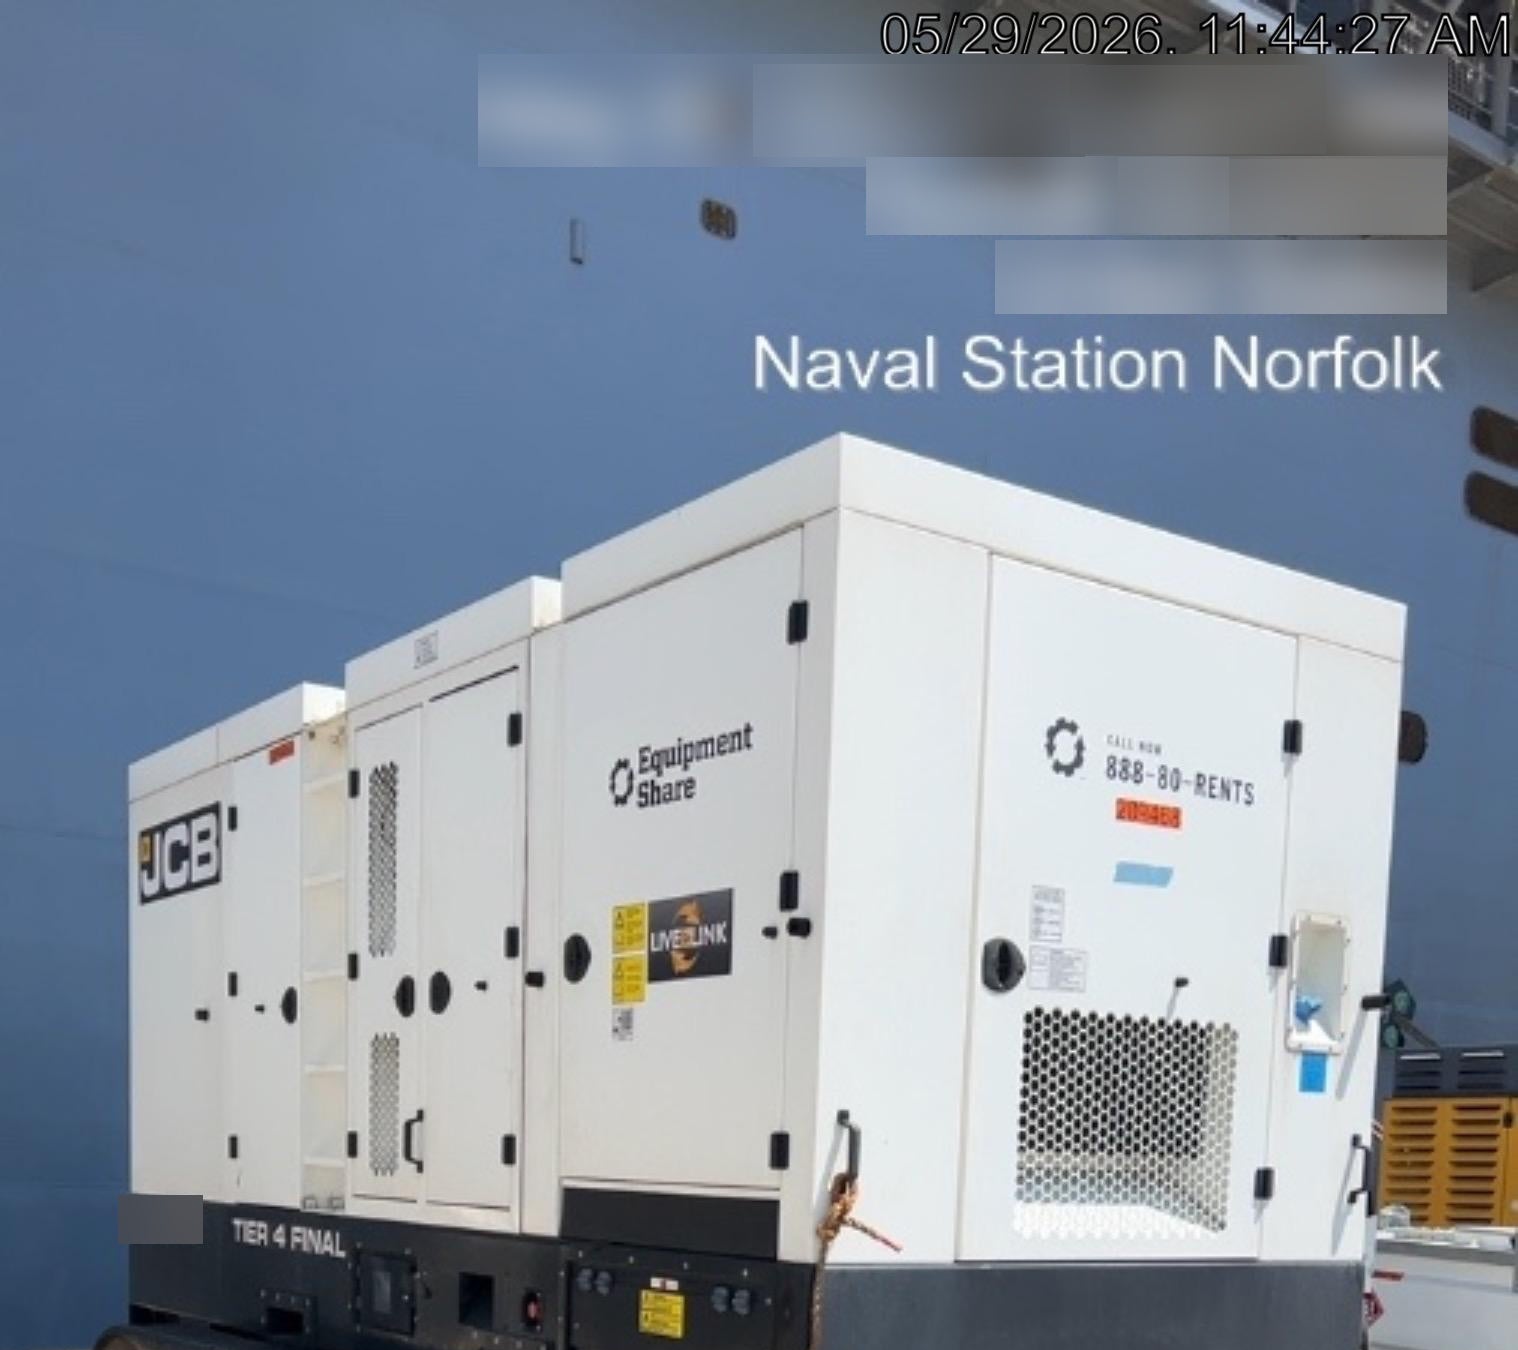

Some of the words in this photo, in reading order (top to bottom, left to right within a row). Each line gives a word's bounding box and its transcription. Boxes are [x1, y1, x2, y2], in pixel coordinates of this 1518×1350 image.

[638, 721, 753, 777] Equipment
[1106, 734, 1134, 751] CALL
[1139, 740, 1162, 755] NOW
[637, 775, 697, 808] Share
[1106, 754, 1255, 807] 888-80-RENTS
[140, 812, 219, 898] JCB
[231, 1217, 268, 1248] TIER
[272, 1223, 286, 1249] 4
[290, 1226, 346, 1258] FINAL
